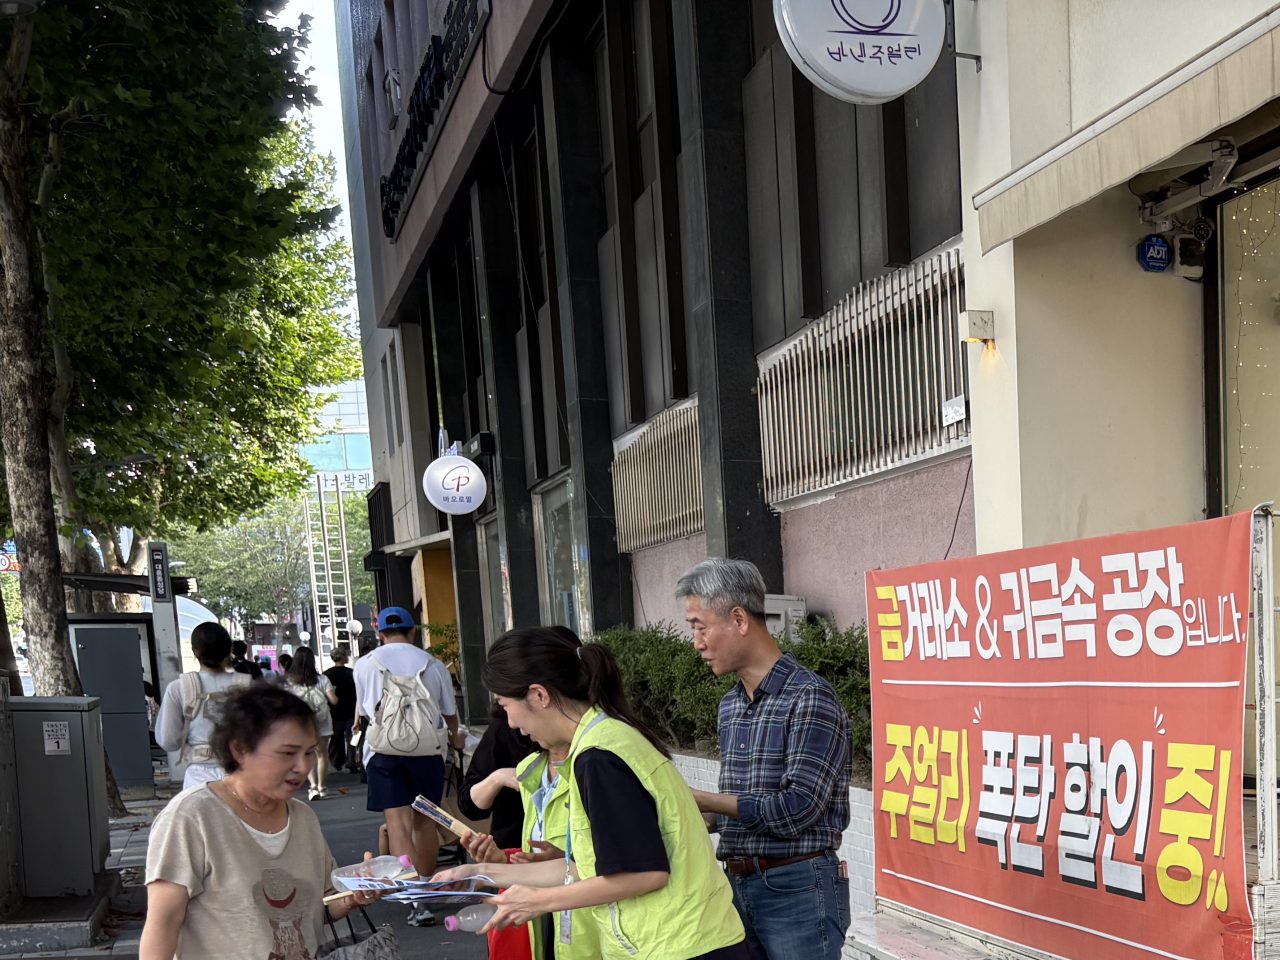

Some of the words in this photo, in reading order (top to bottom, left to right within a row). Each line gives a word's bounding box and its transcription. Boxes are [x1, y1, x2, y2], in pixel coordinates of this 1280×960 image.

[1147, 245, 1167, 259] ADT
[875, 576, 971, 661] 금거래소
[975, 575, 1001, 659] &
[1000, 558, 1097, 660] 귀금속
[881, 724, 970, 853] 주얼리
[975, 730, 1055, 876] 폭탄
[1057, 732, 1153, 901] 할인
